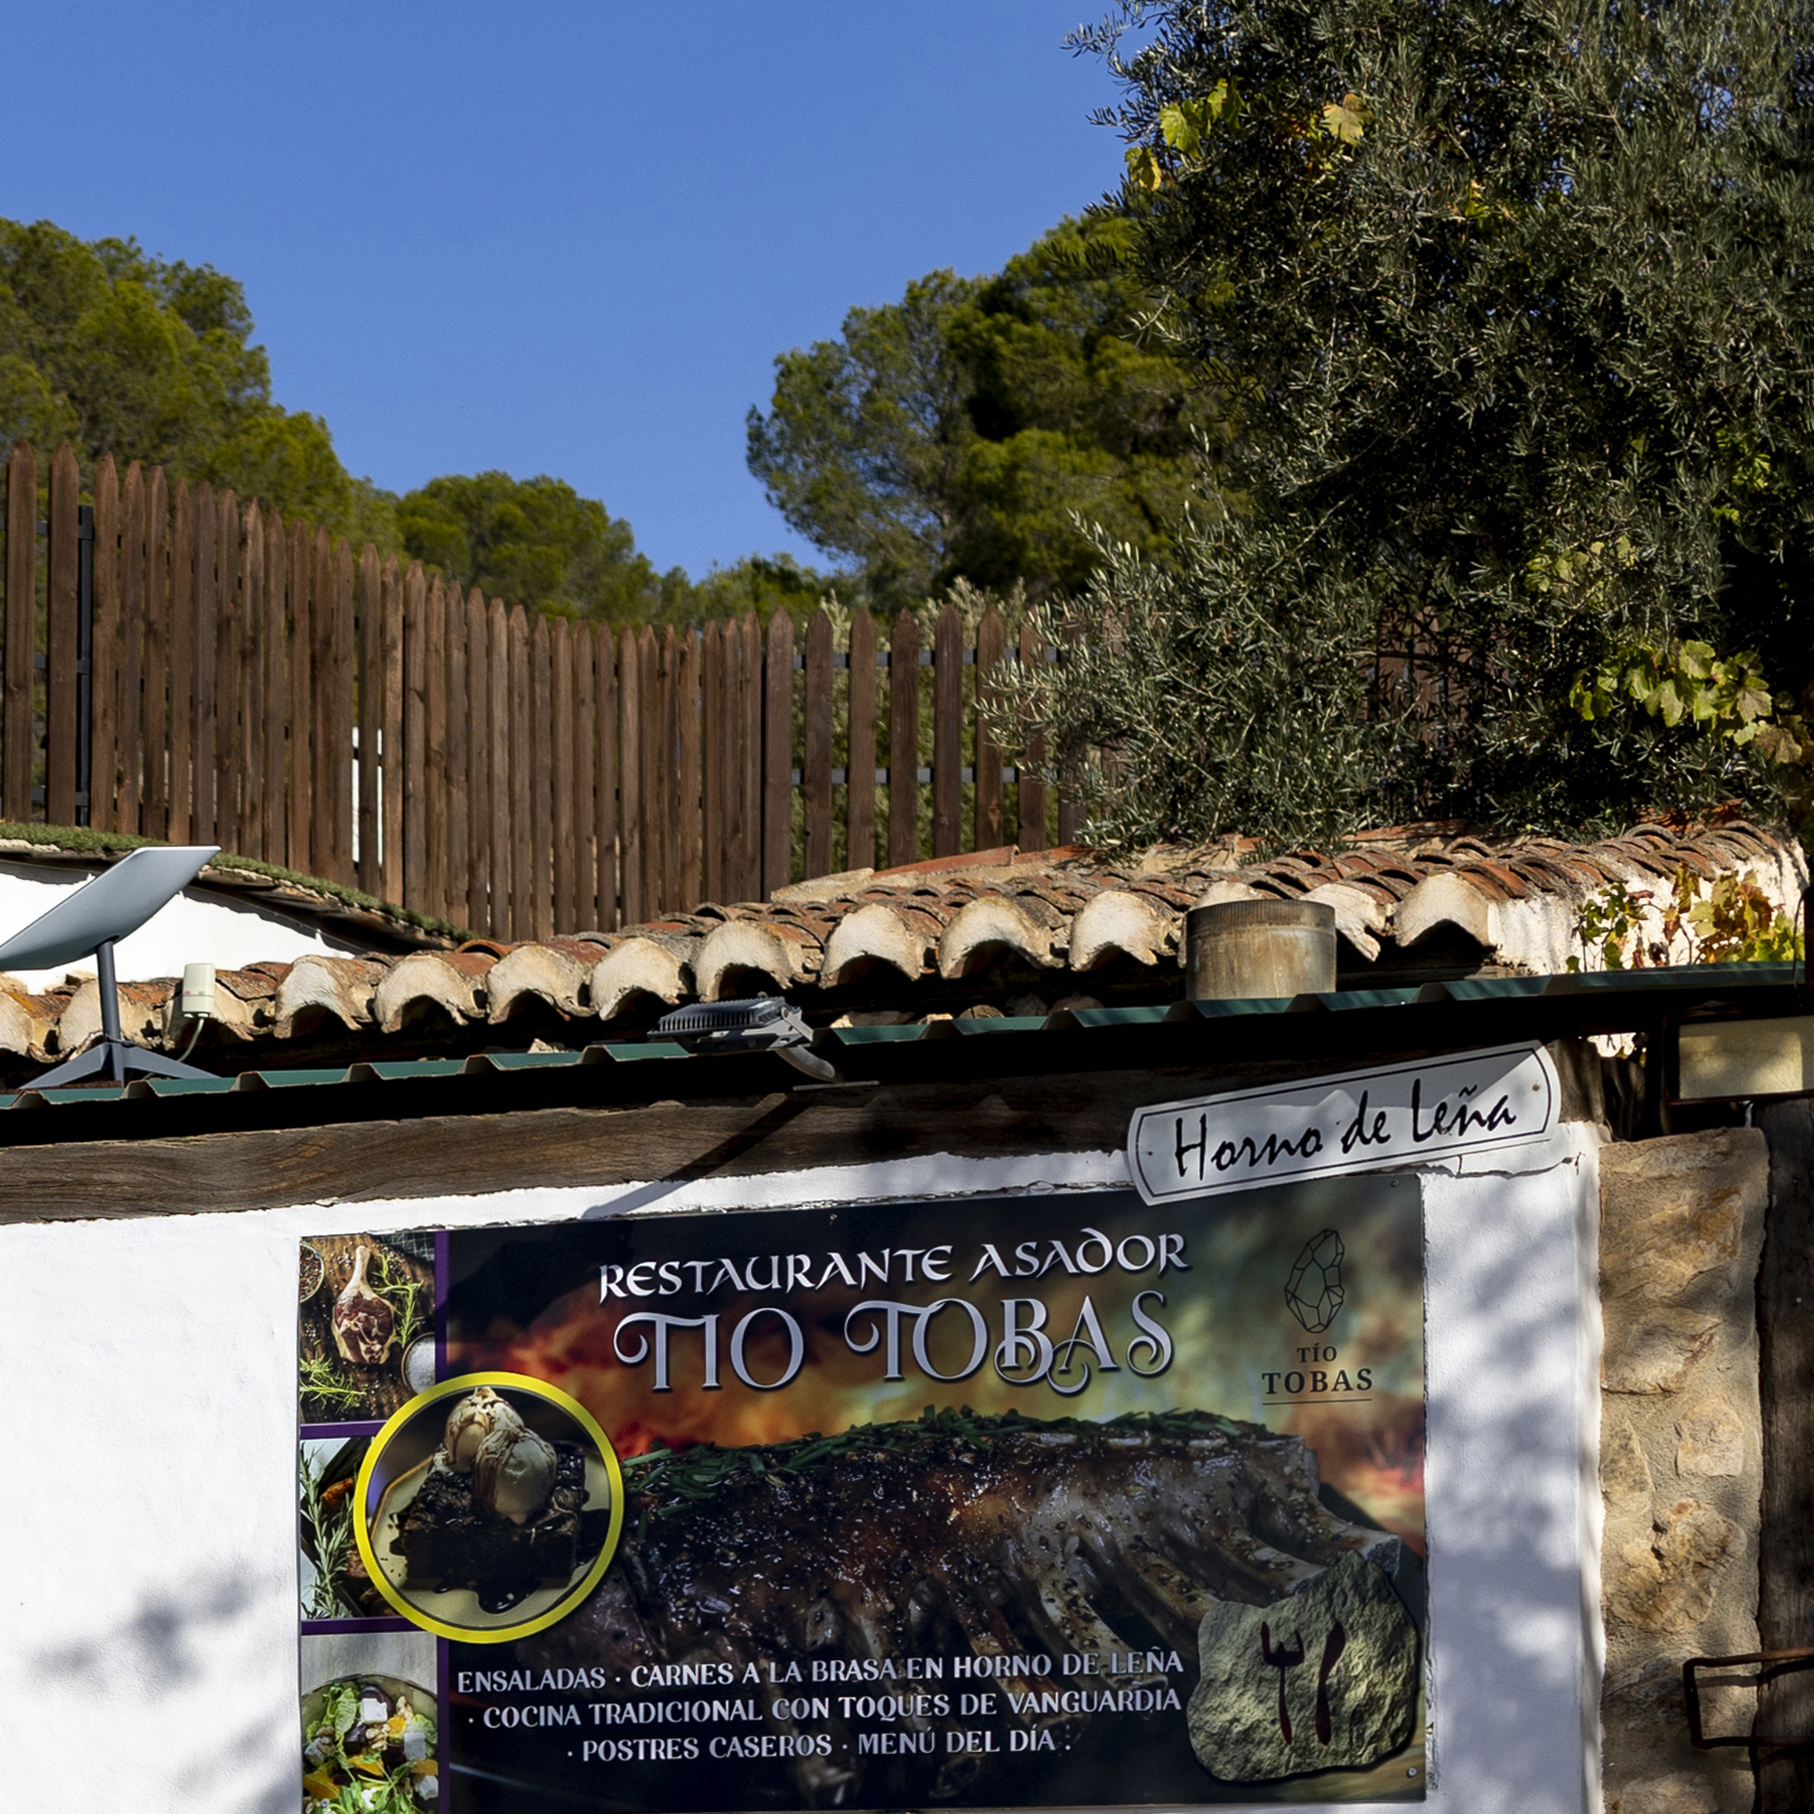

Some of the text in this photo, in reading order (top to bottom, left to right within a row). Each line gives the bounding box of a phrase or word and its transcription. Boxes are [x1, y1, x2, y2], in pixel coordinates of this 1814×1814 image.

[1174, 1112, 1323, 1181] Horno
[1341, 1090, 1392, 1154] de
[598, 1226, 1191, 1304] RESTAURANTE ASADOR
[613, 1289, 1174, 1394] TIO TOBAS
[1297, 1342, 1337, 1363] TÍO
[1261, 1368, 1373, 1395] TOBAS
[457, 1646, 1185, 1693] ENSALADAS CARNES A LA BRASA EN HORNO DE LEÑA
[482, 1688, 1182, 1729] COCINA TRADICIONAL CON TOQUES DE VANGUARDIA
[582, 1724, 1056, 1762] POSTRES CASEROS MENÚ DEL DÍA
